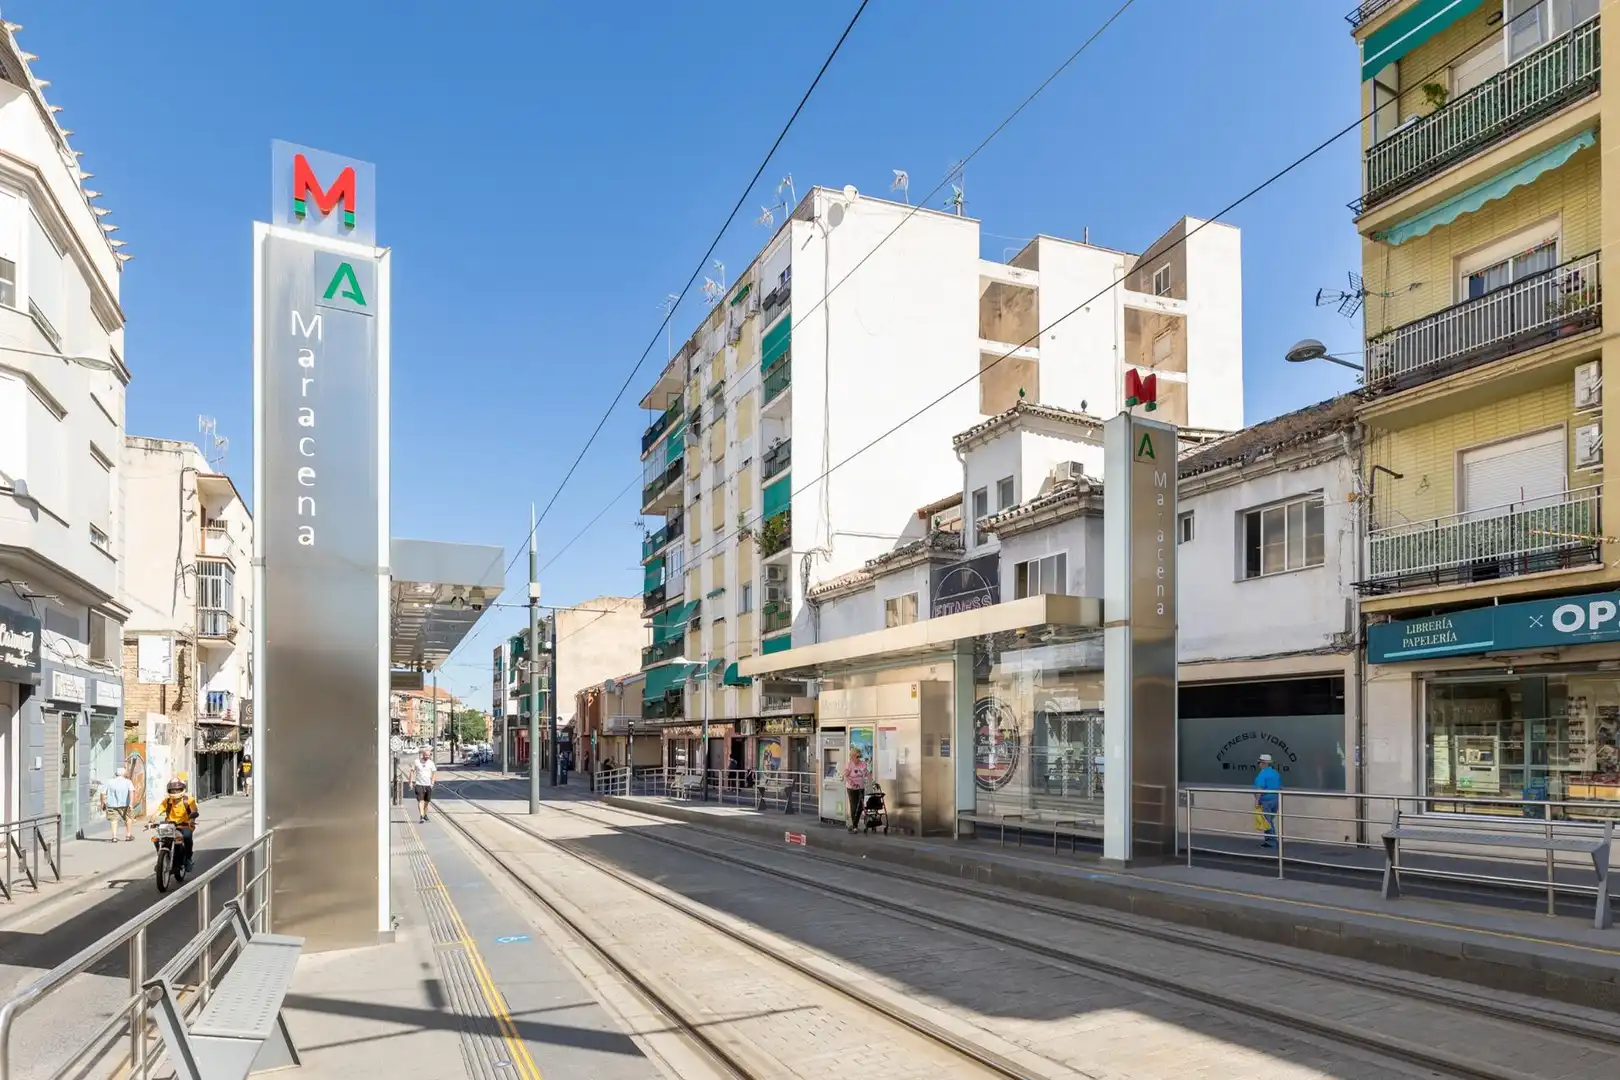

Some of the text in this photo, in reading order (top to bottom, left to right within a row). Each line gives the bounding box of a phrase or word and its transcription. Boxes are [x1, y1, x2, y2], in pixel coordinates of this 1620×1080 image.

[293, 154, 356, 228] M
[1126, 368, 1157, 411] M
[291, 310, 323, 546] Maracena
[1154, 471, 1168, 615] Maracena
[1406, 617, 1453, 635] LIBRERÍA
[1552, 599, 1620, 633] OP
[1402, 630, 1458, 648] PAPELERÍA
[1216, 731, 1298, 763] FITNESS WORLD
